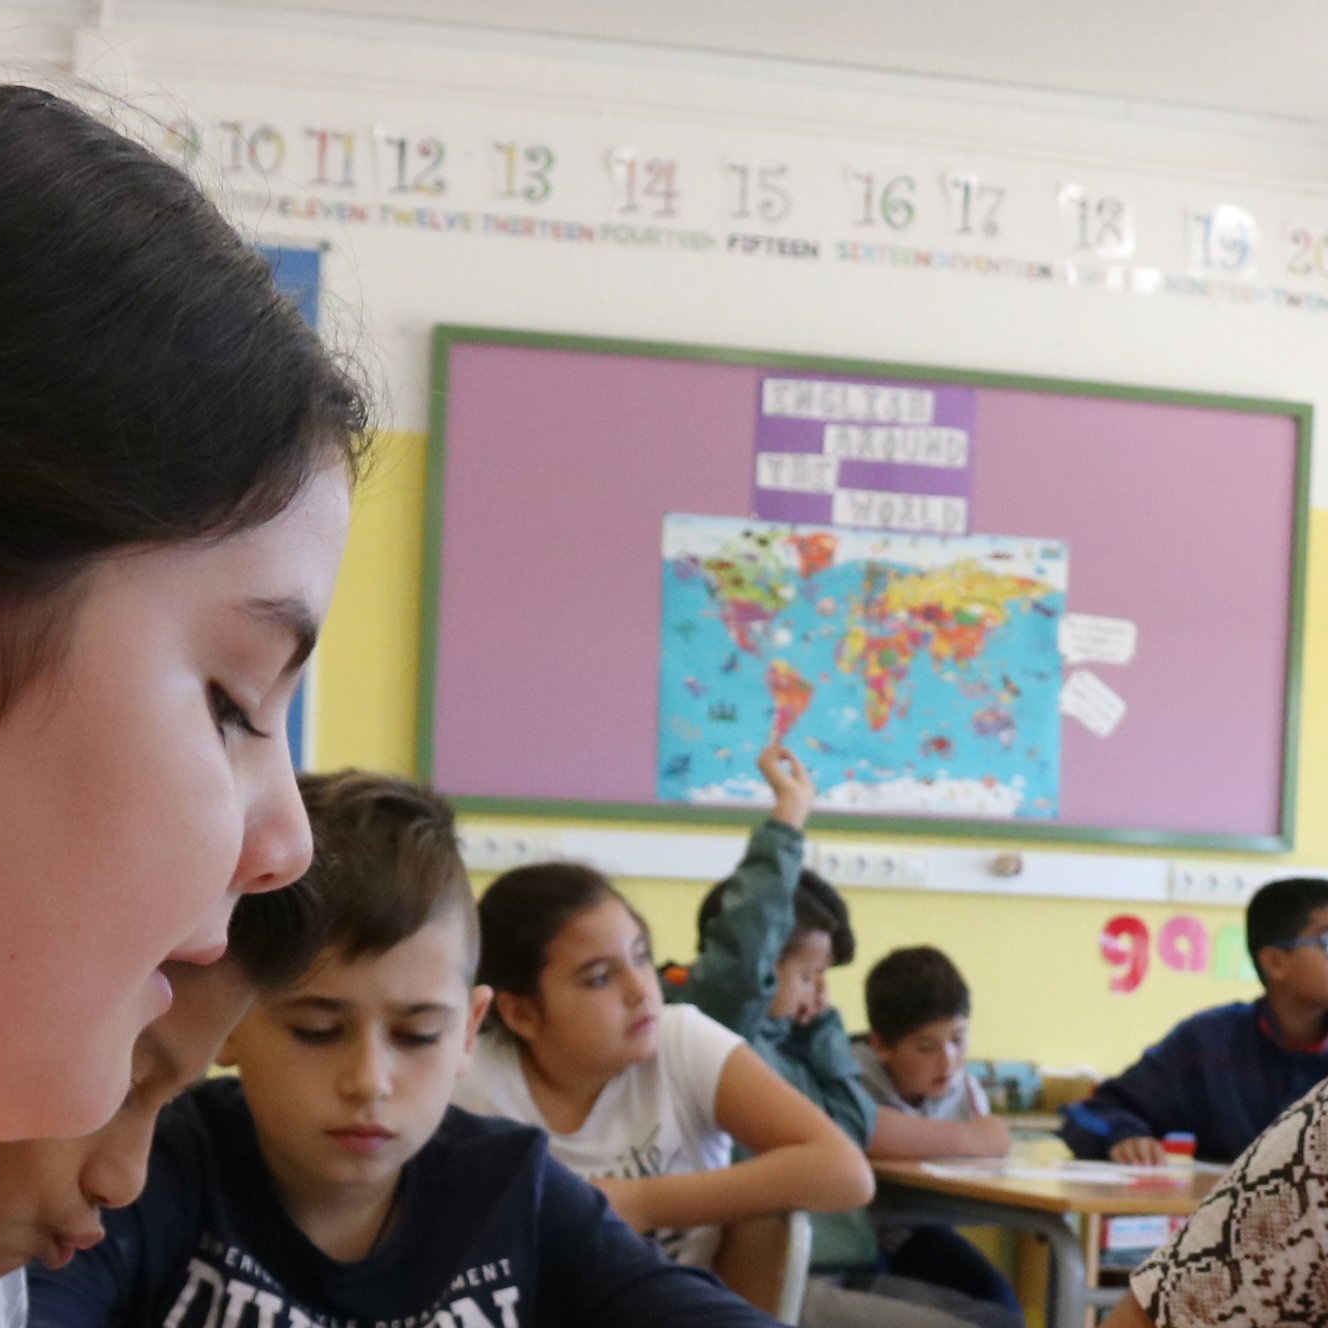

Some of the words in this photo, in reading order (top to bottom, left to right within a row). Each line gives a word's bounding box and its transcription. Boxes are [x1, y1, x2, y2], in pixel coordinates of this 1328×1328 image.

[220, 120, 287, 176] 10
[305, 127, 356, 189] 11
[386, 136, 446, 196] 12
[493, 142, 555, 205] 13
[615, 156, 680, 217] 14
[727, 163, 791, 223] 15
[853, 171, 916, 231] 16
[952, 179, 1007, 238] 17
[1073, 195, 1125, 249] 18
[1191, 211, 1253, 269] 19
